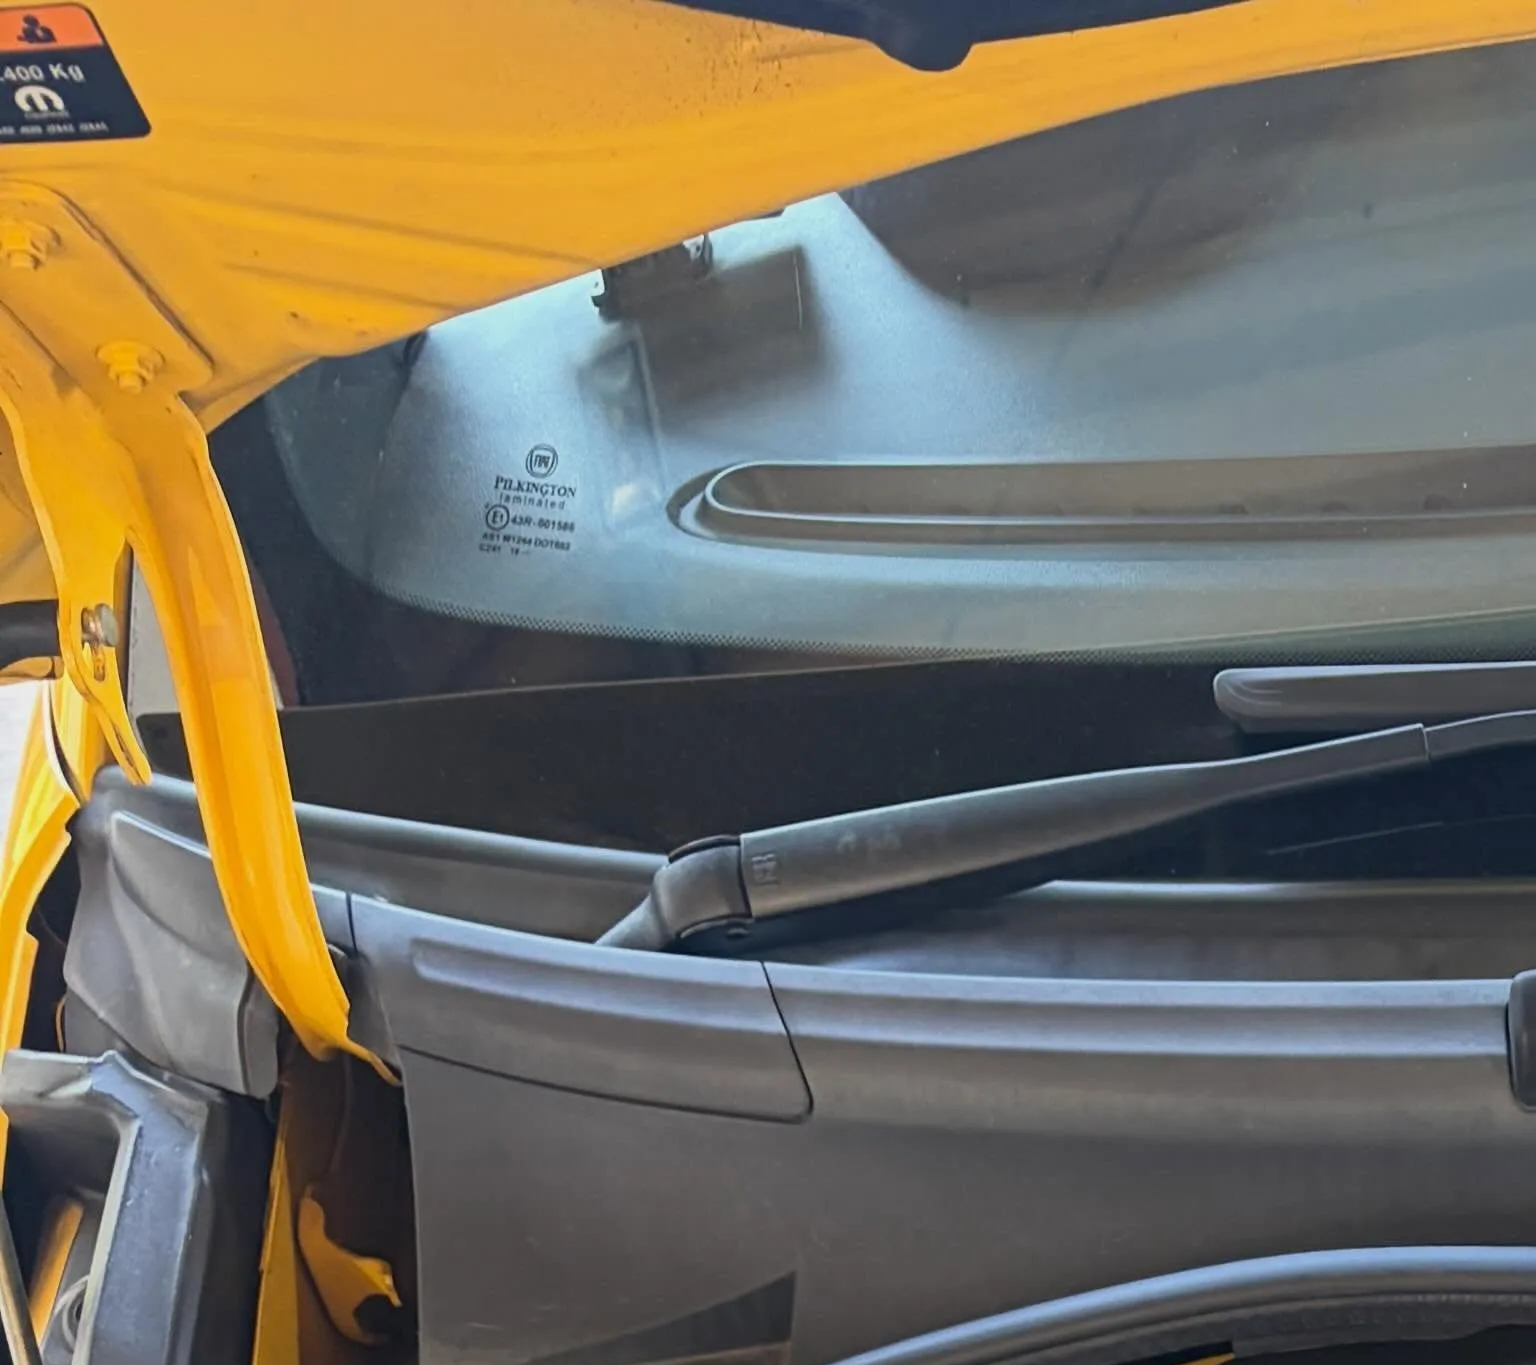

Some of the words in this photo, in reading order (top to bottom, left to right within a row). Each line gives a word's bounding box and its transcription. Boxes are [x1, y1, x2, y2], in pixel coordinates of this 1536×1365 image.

[48, 62, 85, 83] Kg
[494, 475, 576, 498] PILKINGTON
[500, 492, 565, 510] laminated
